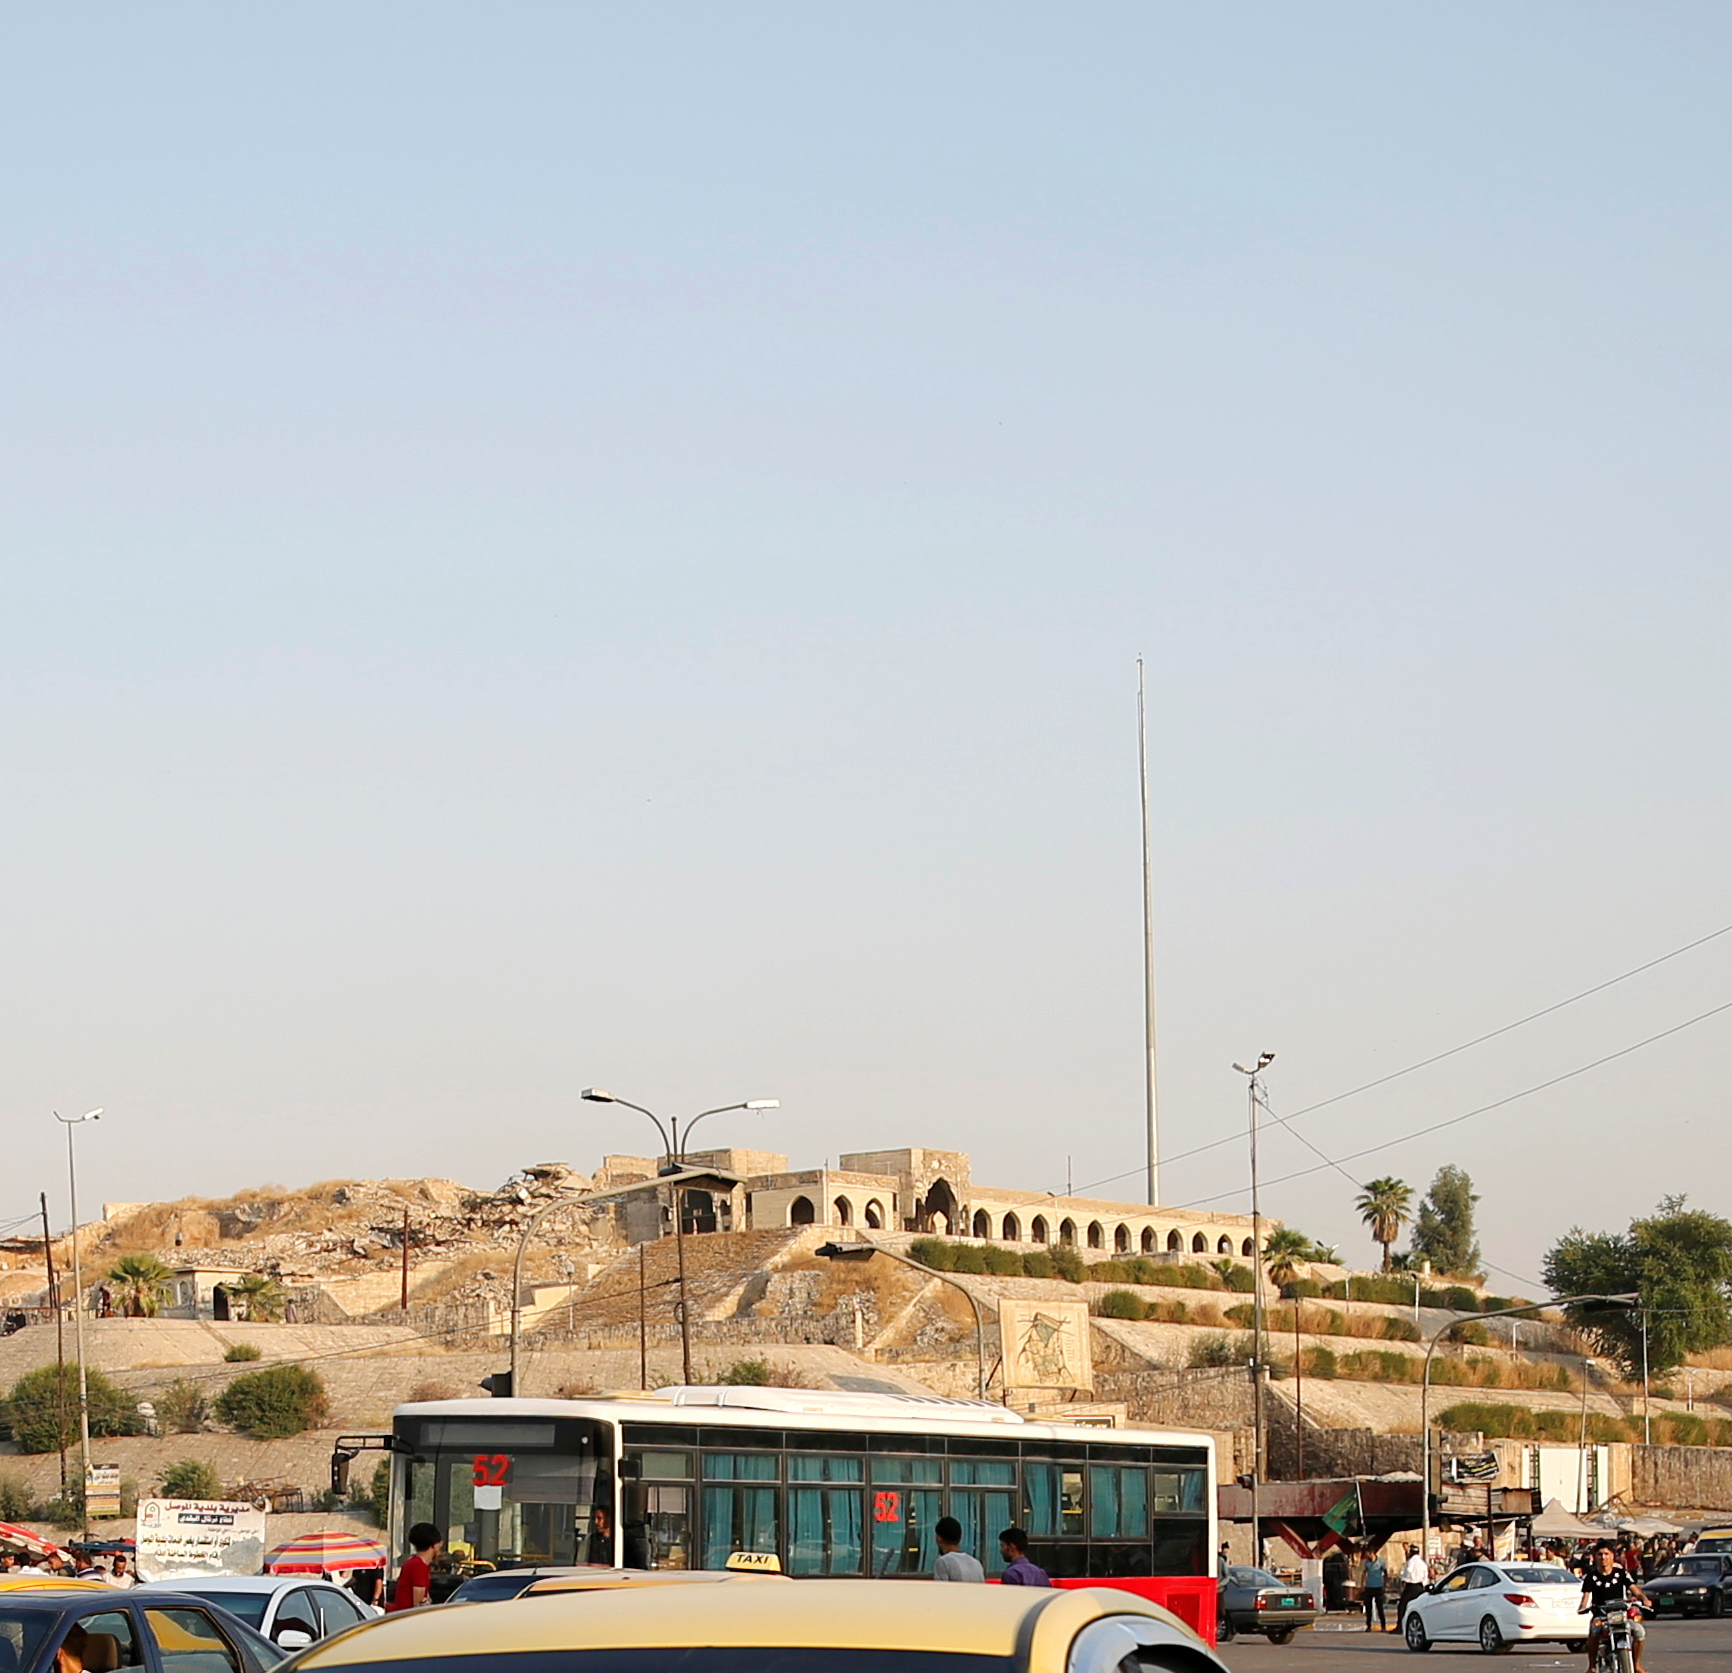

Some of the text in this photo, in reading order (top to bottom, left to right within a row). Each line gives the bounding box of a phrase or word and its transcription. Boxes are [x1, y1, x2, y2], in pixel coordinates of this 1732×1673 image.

[472, 1454, 510, 1487] 52
[165, 1502, 250, 1514] مديرية بلدية الموصل
[874, 1491, 900, 1522] 52
[736, 1554, 769, 1564] TAXI
